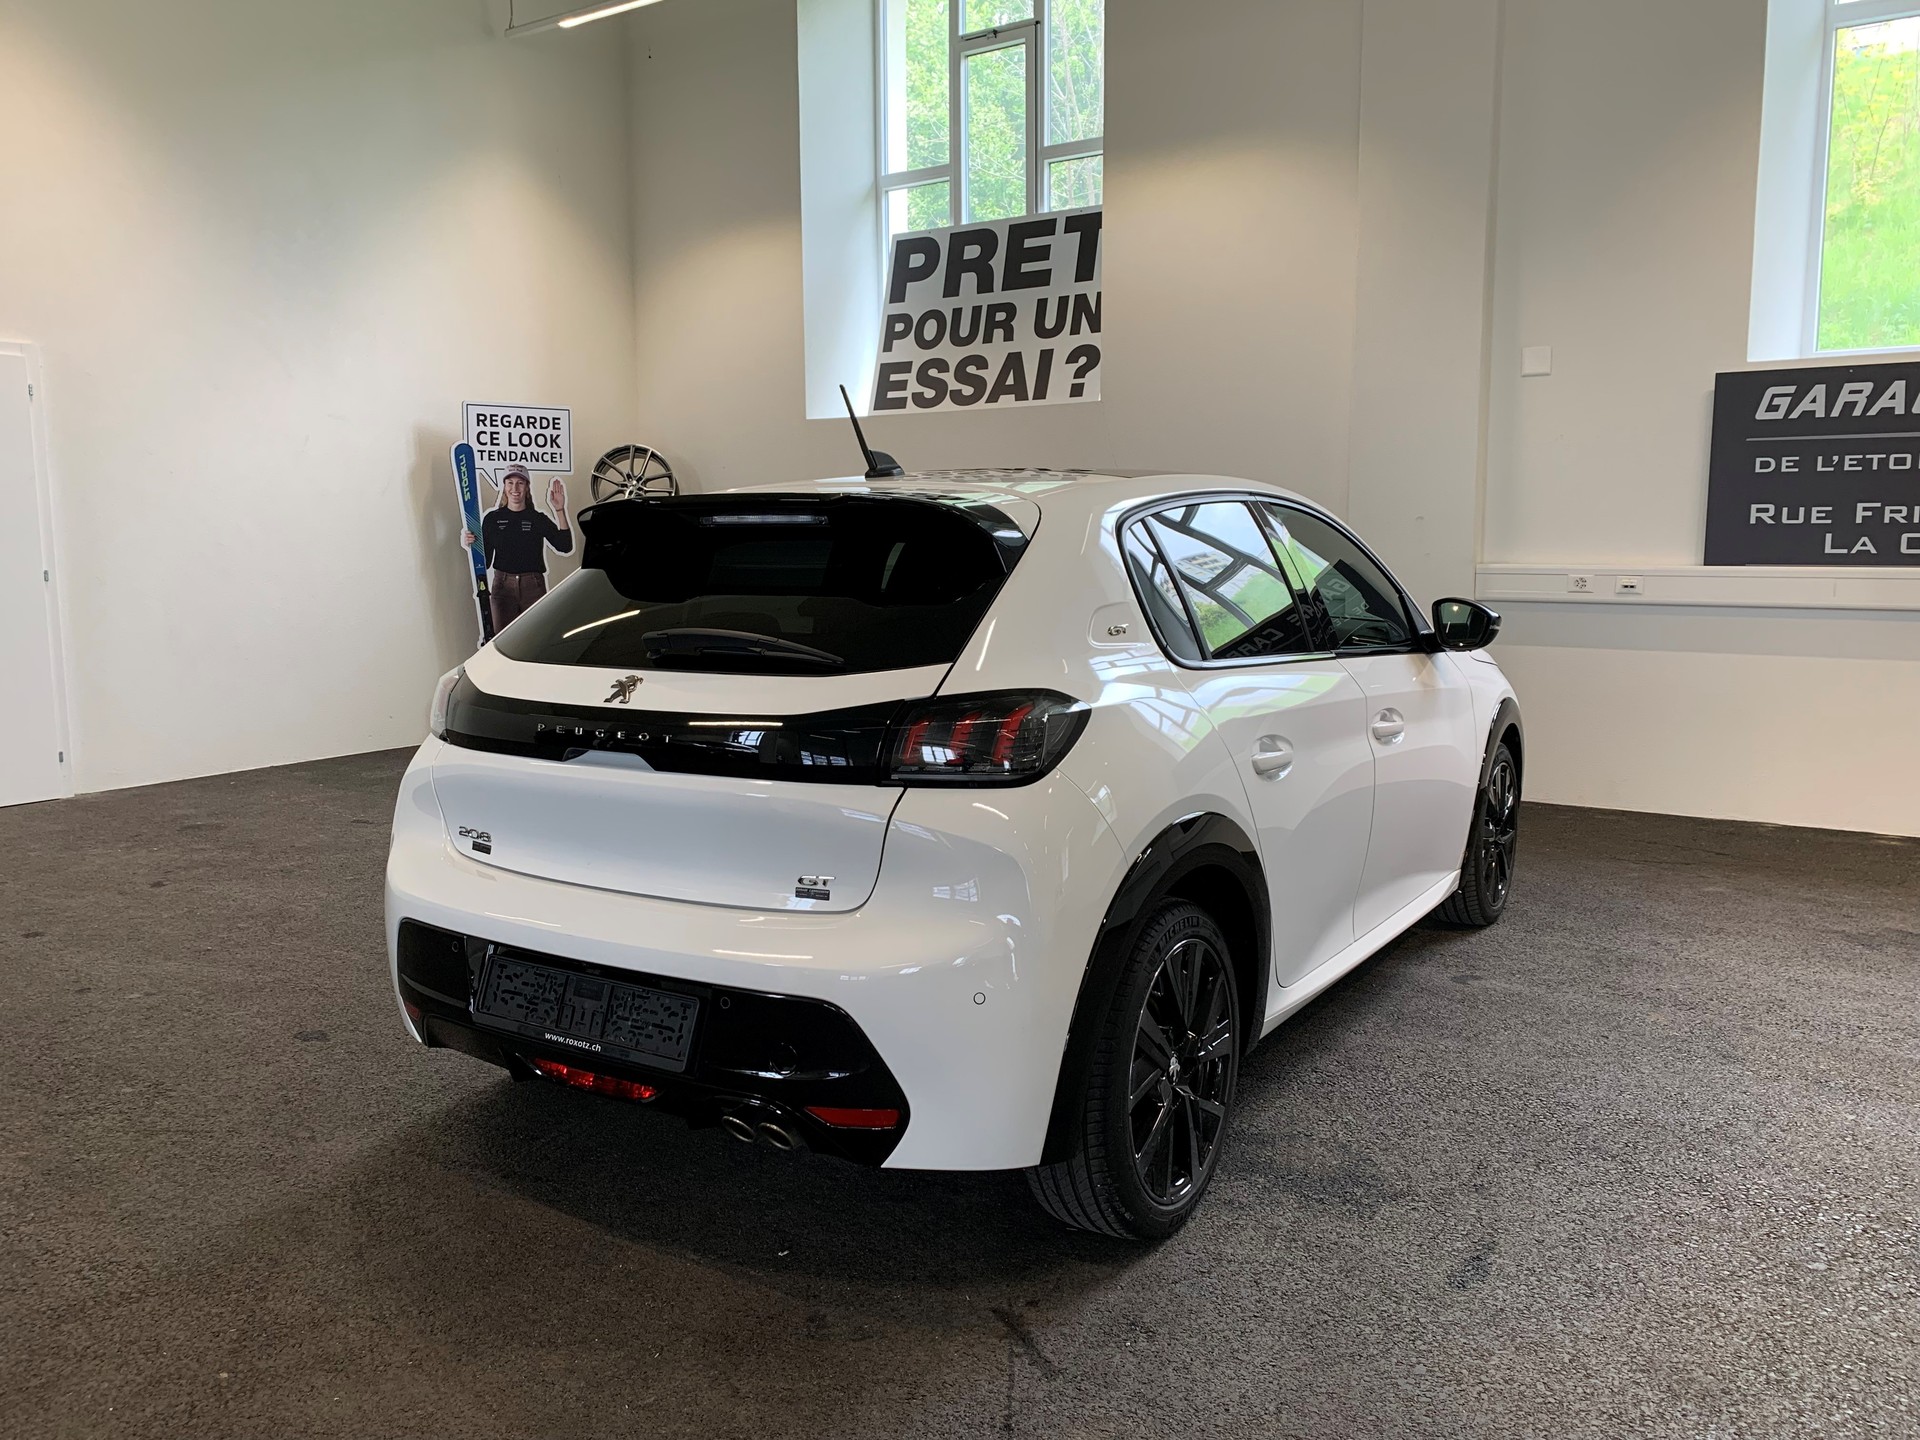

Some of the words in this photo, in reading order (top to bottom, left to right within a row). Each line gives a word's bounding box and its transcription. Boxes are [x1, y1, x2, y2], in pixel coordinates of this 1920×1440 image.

[889, 211, 1102, 304] PRET
[882, 302, 1017, 353] POUR
[1034, 291, 1101, 339] UN
[873, 348, 1054, 409] ESSAI
[1065, 344, 1101, 398] ?
[476, 413, 561, 430] REGARDE
[476, 431, 500, 446] CE
[508, 432, 561, 448] LOOK
[477, 450, 563, 463] TENDANCE!
[1755, 457, 1799, 473] DE
[1817, 453, 1920, 471] L'ETO
[538, 723, 672, 743] PEUGEOT
[459, 826, 491, 843] 208
[798, 875, 836, 887] GT
[545, 1032, 602, 1052] www.roxotz.ch
